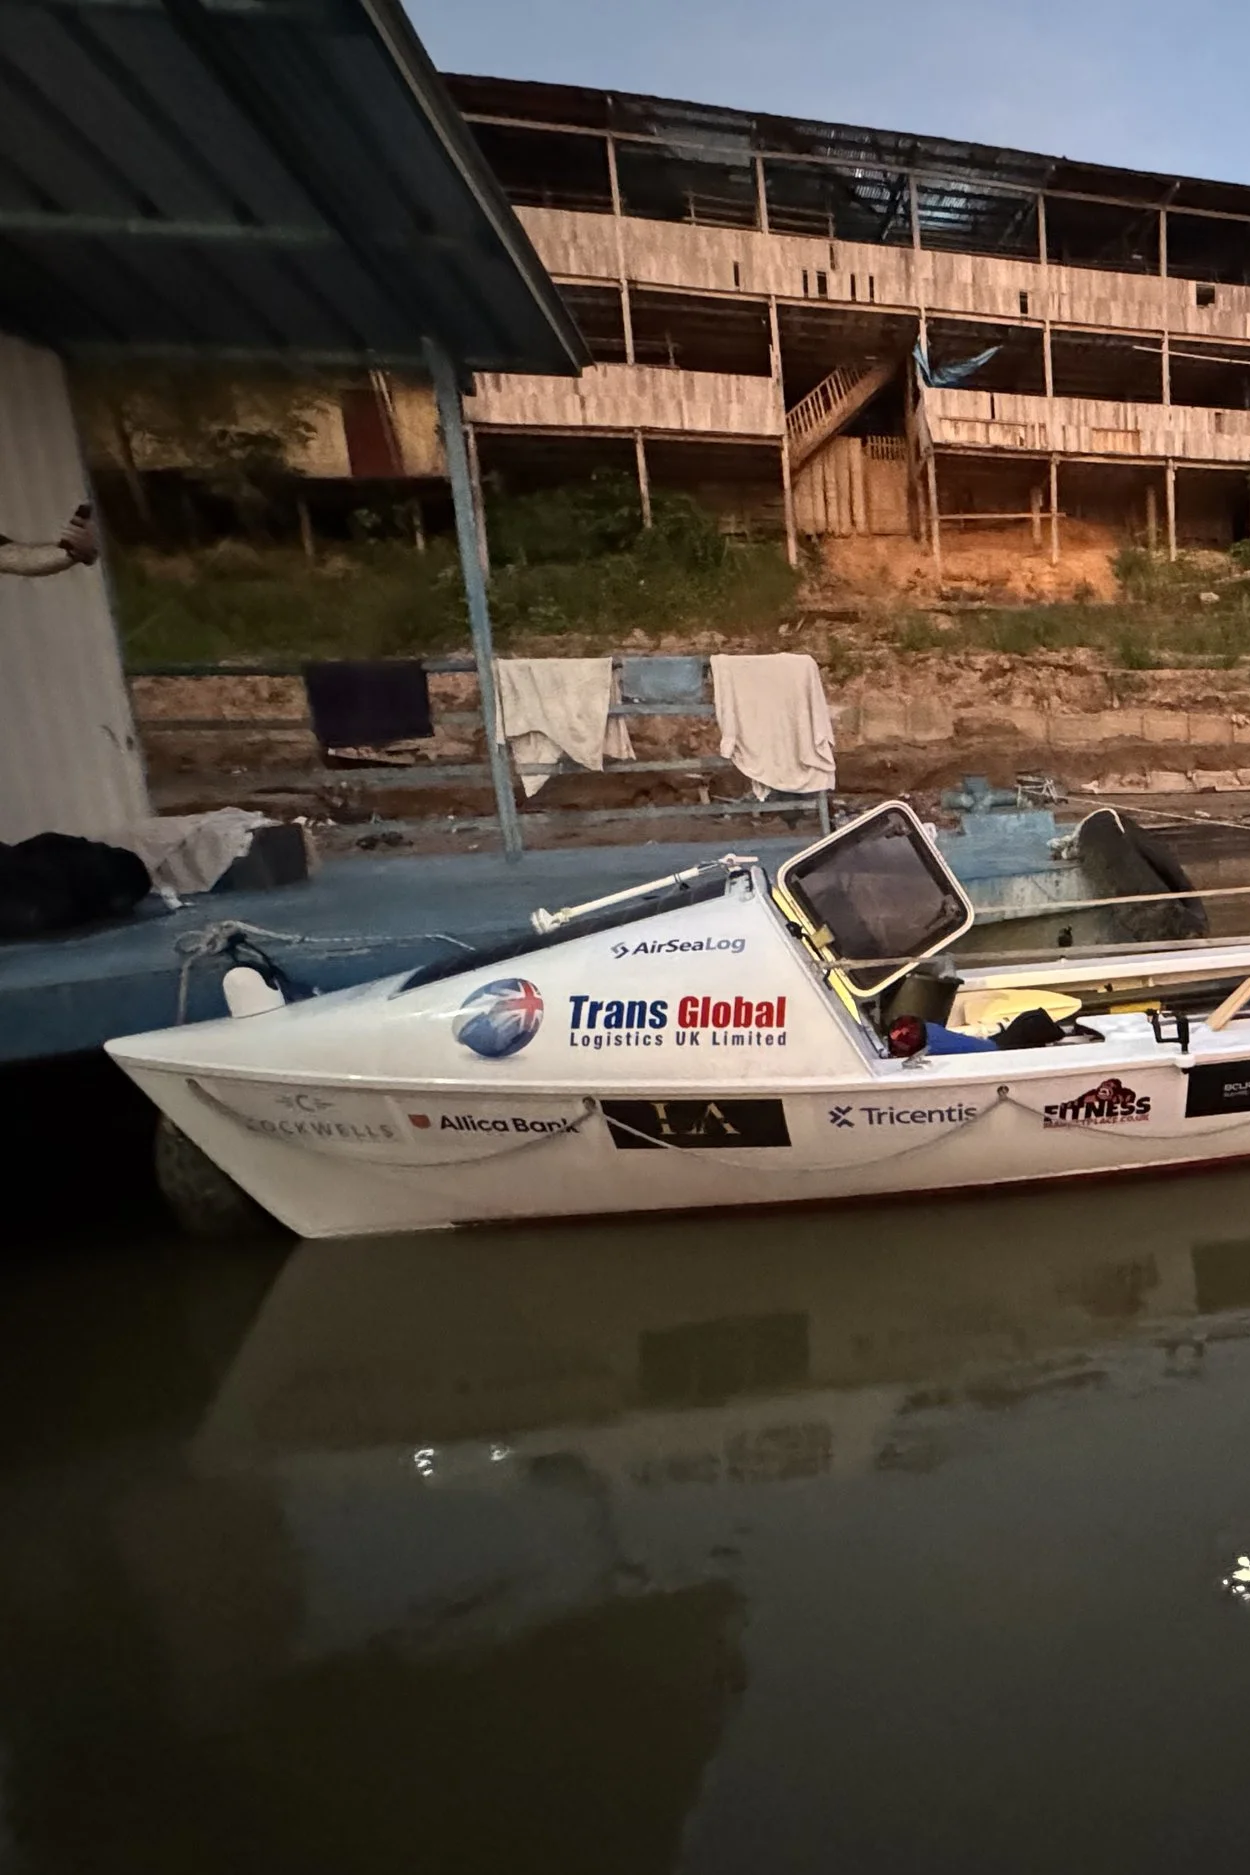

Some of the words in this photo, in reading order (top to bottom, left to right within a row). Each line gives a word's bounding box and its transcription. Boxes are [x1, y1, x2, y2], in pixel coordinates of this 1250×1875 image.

[631, 937, 746, 955] AirSeaLog
[569, 995, 668, 1029] Trans
[677, 995, 786, 1029] Global
[569, 1032, 664, 1050] Logistics
[675, 1032, 700, 1046] UK
[711, 1031, 787, 1046] Limited
[859, 1103, 978, 1125] Tricentis
[1043, 1096, 1151, 1122] FITNESS
[439, 1114, 510, 1133] Allica
[511, 1117, 581, 1134] Bank
